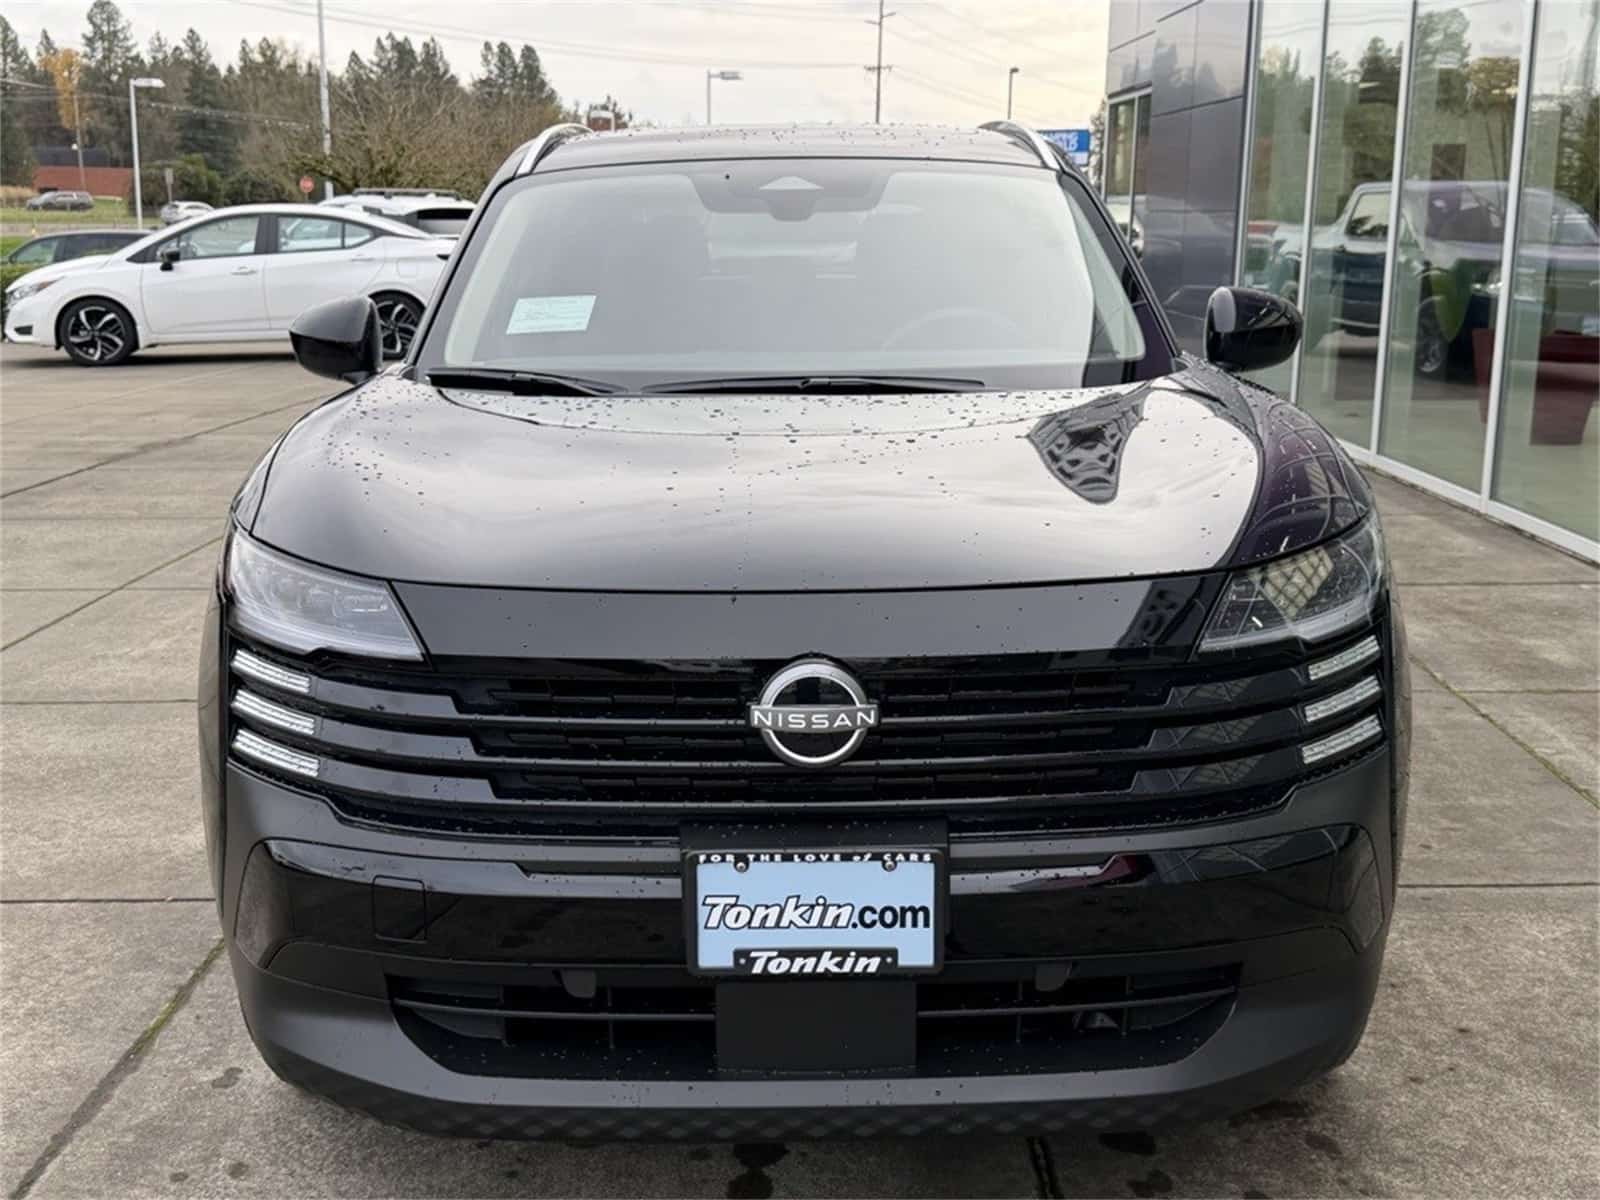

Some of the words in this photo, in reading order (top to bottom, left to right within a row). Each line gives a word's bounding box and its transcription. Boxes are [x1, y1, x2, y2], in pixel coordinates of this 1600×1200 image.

[753, 710, 875, 729] NISSAN
[699, 854, 735, 864] FOR
[747, 854, 782, 862] THE
[793, 854, 841, 862] LOVE
[883, 853, 931, 862] CARS
[703, 895, 931, 930] Tonkin.com
[750, 950, 881, 974] Tonkin
